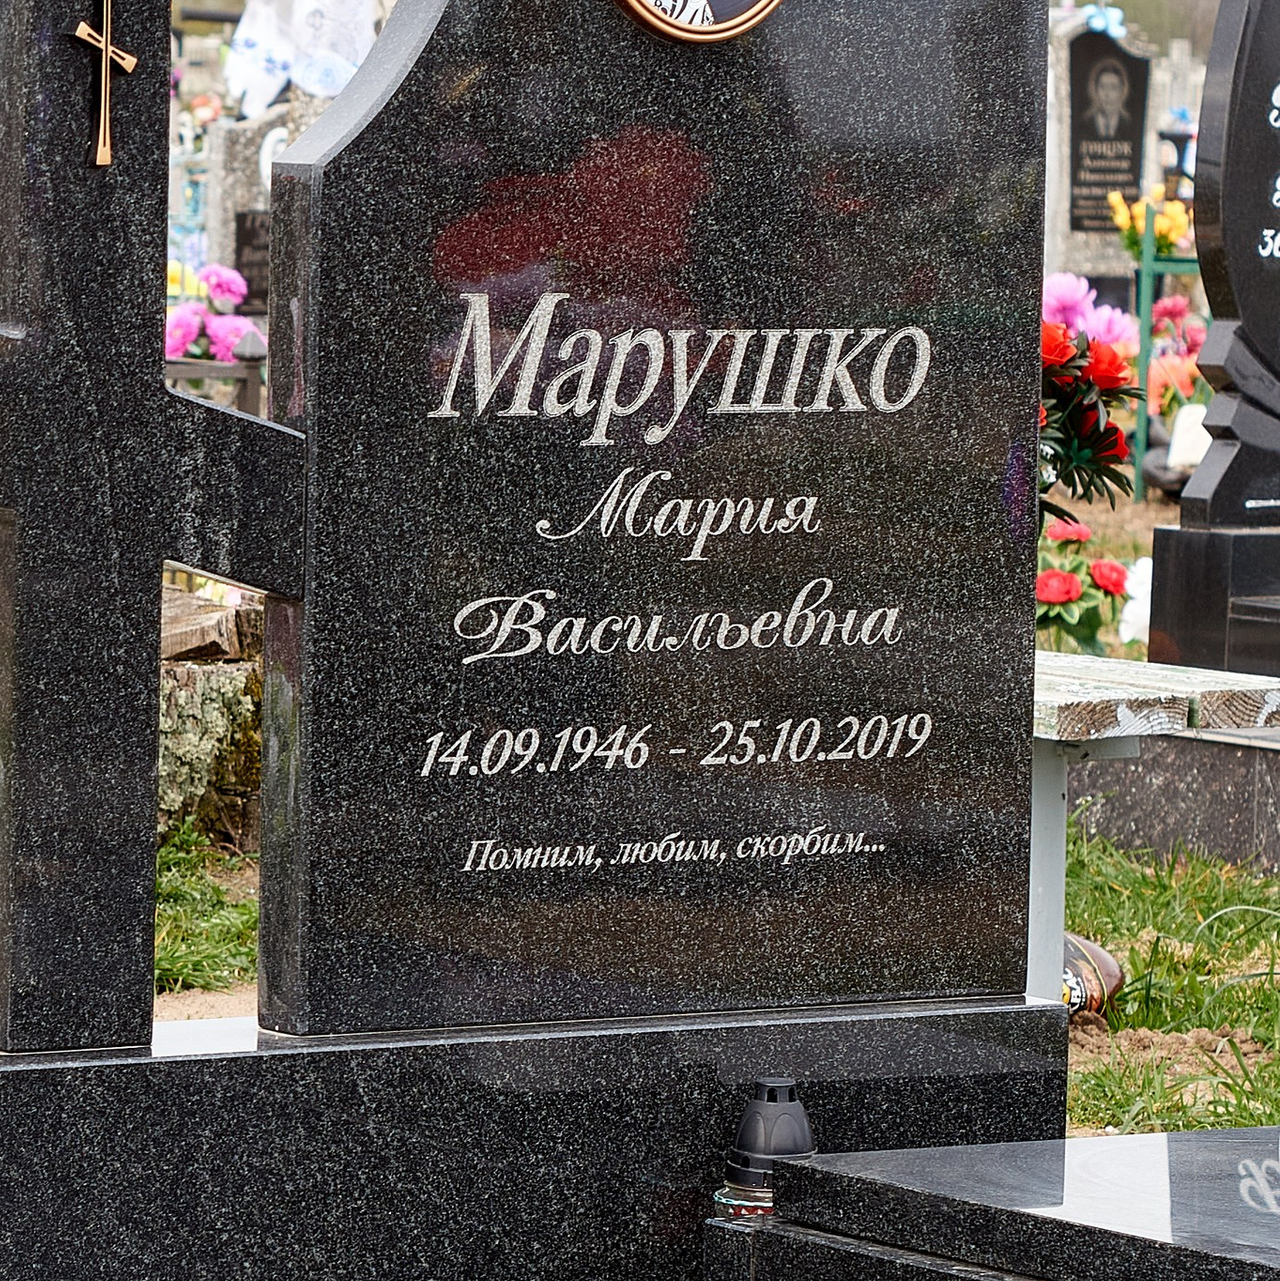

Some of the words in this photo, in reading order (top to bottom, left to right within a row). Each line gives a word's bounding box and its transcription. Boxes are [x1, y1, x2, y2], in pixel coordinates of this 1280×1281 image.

[428, 292, 933, 446] Марушко
[536, 466, 822, 562] Мария
[453, 576, 904, 665] Васильевна
[420, 723, 653, 779] 14.09.1946
[702, 713, 933, 768] 25.10.2019
[461, 840, 604, 874] Помним,
[610, 831, 727, 866] любим,
[736, 826, 887, 866] скорбим...
